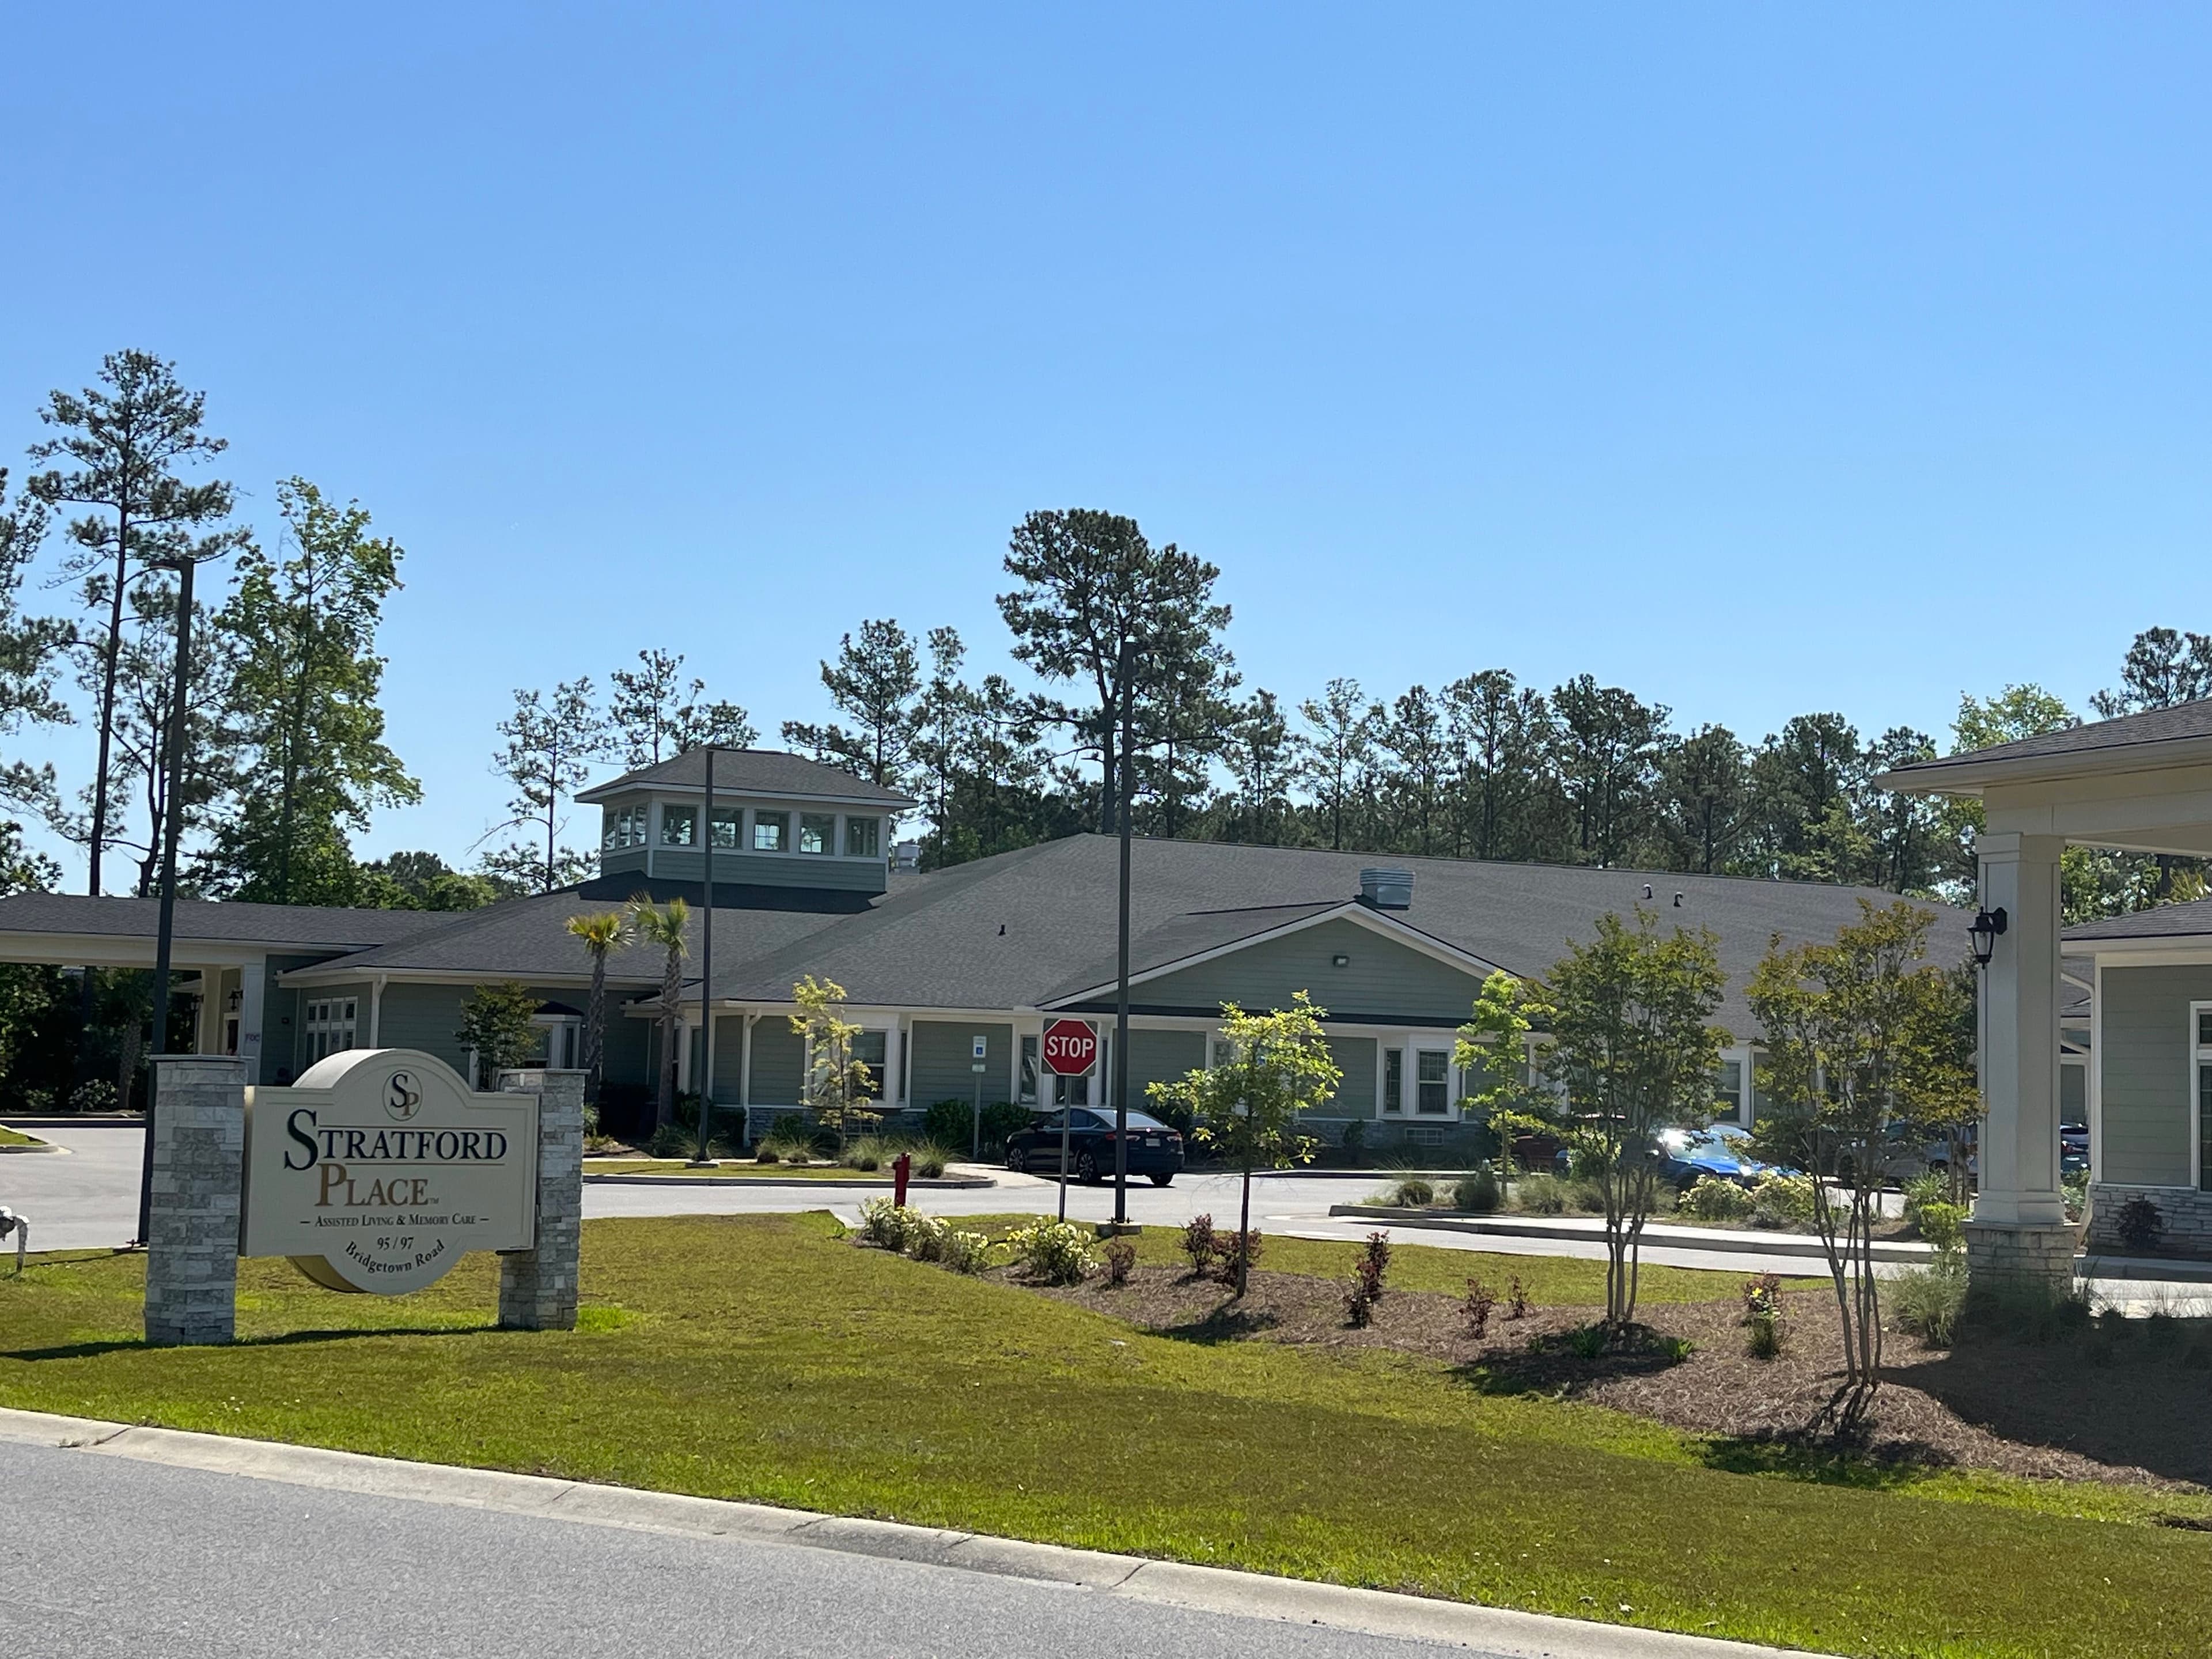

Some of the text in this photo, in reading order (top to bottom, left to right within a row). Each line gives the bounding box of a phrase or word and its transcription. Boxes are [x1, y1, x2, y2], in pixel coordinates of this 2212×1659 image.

[1047, 1036, 1094, 1058] STOP
[284, 1109, 507, 1171] STRATFORD
[315, 1163, 428, 1206] PLACE
[315, 1213, 476, 1227] ASSISTED LIVING & MEMORY CARE
[346, 1238, 445, 1274] Bridgetown Road
